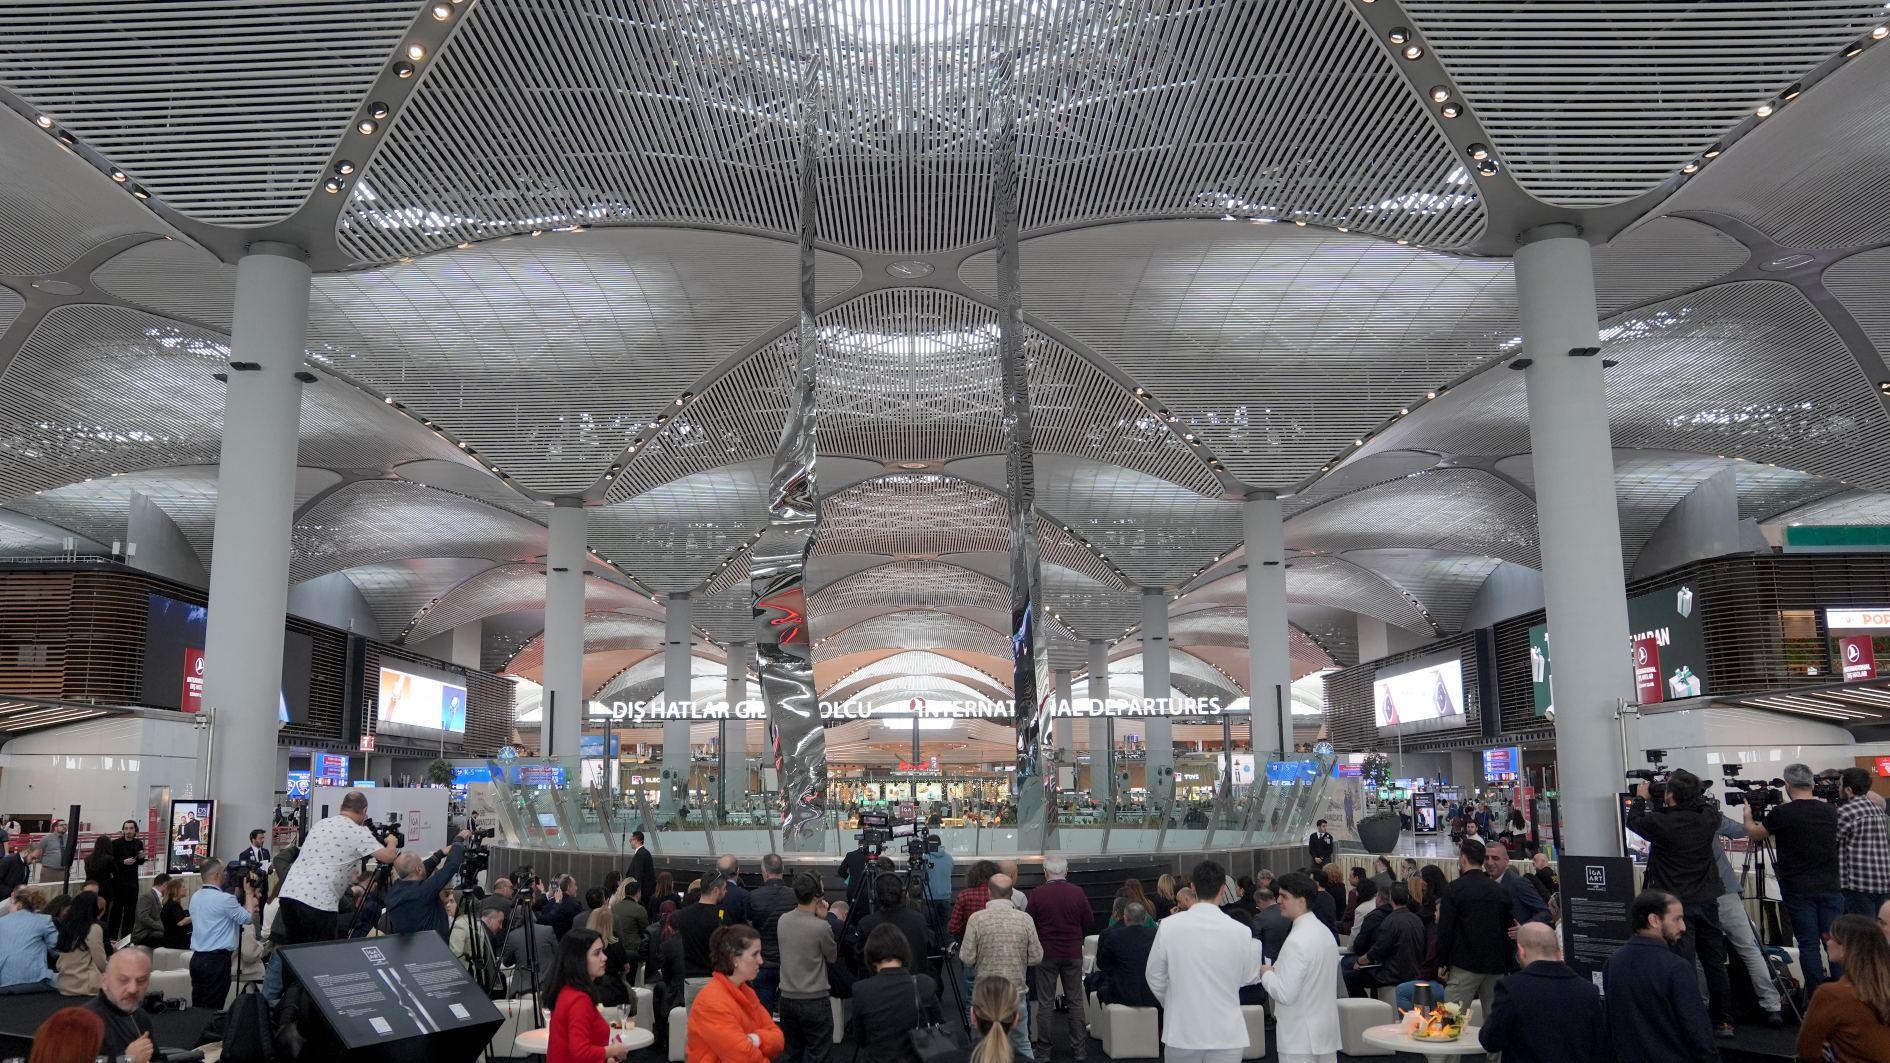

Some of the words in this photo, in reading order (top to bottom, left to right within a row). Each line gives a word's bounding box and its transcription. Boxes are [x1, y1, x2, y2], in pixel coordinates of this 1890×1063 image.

[613, 701, 646, 723] DIŞ
[651, 700, 730, 719] HATLAR
[818, 701, 872, 719] OLCU
[1089, 697, 1222, 716] DEPARTURES
